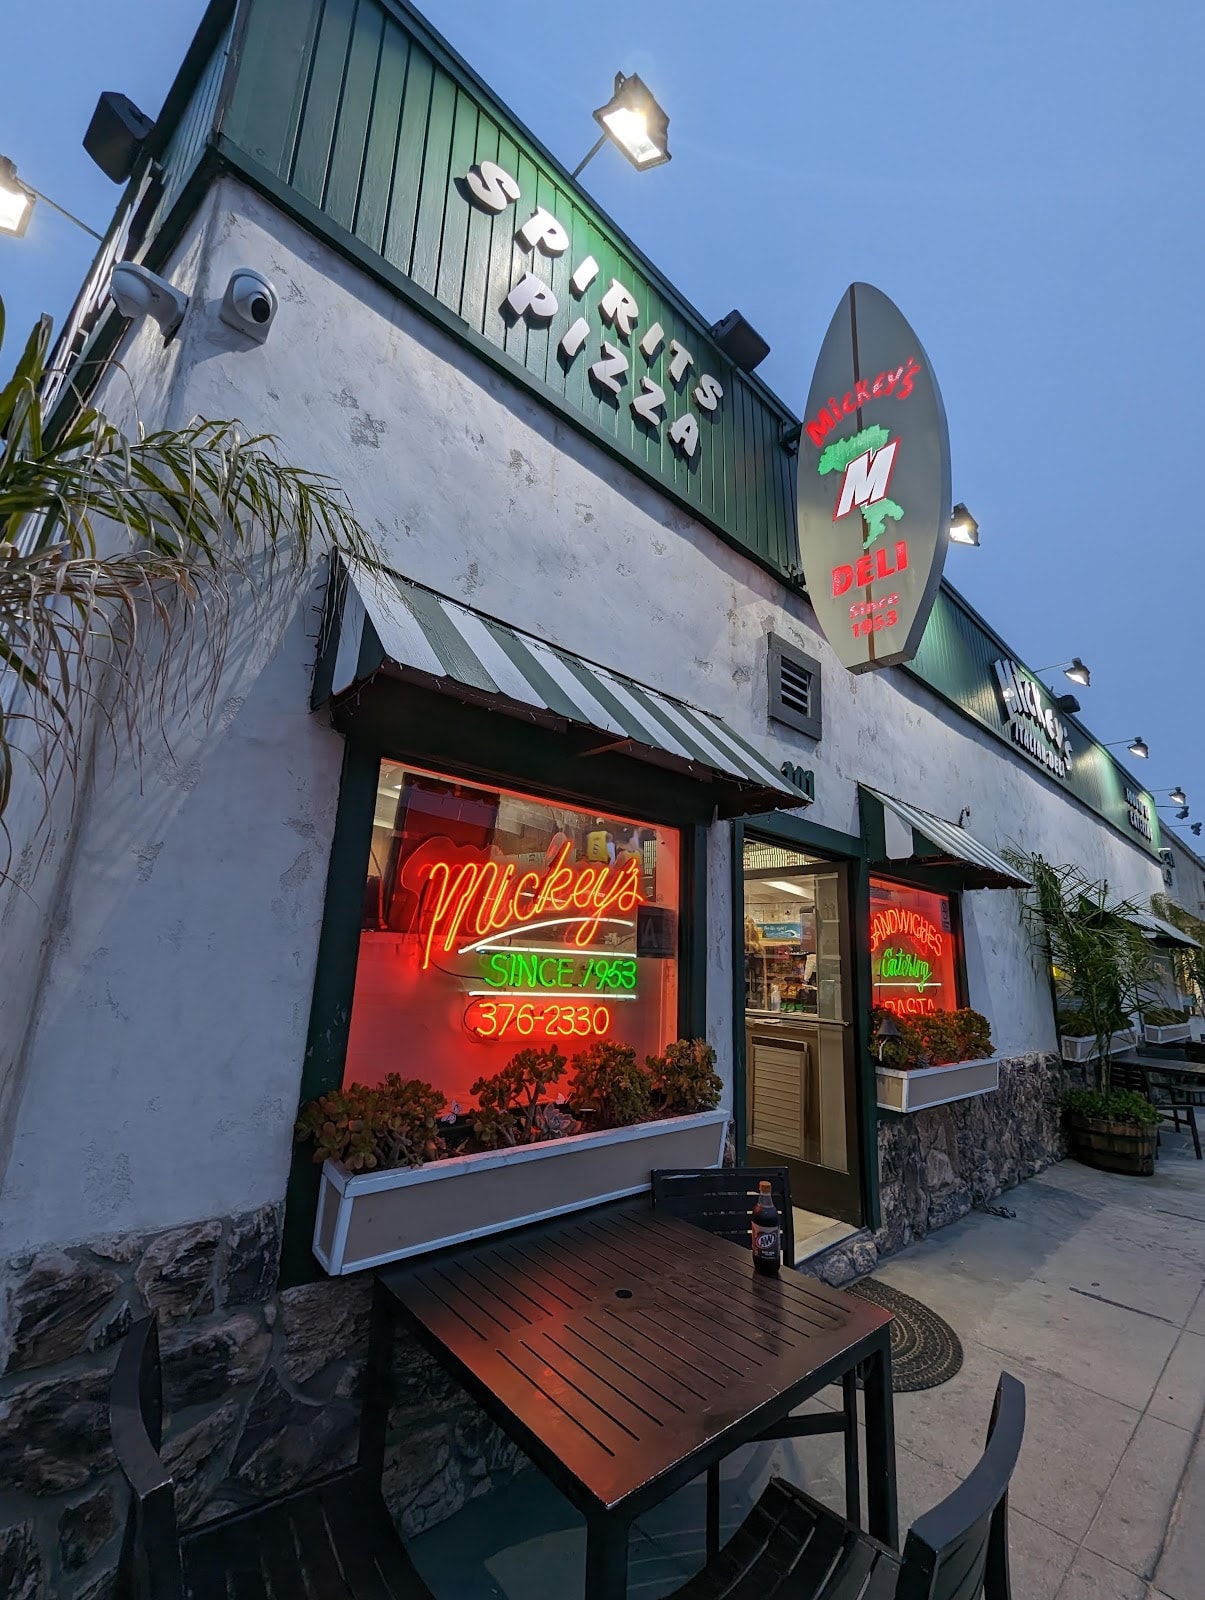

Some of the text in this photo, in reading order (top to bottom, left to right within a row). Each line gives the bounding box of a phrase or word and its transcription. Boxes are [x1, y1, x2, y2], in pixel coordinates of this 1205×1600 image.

[467, 161, 724, 411] SPIRITS
[508, 272, 699, 457] PIZZA
[833, 437, 900, 521] M
[832, 539, 908, 597] DELI
[851, 609, 898, 638] 1953
[1012, 719, 1046, 764] ITALIAN
[422, 841, 643, 969] Mickey's
[485, 953, 638, 990] SINCE 1953
[882, 947, 932, 993] Catering
[476, 1002, 610, 1037] 376-2330
